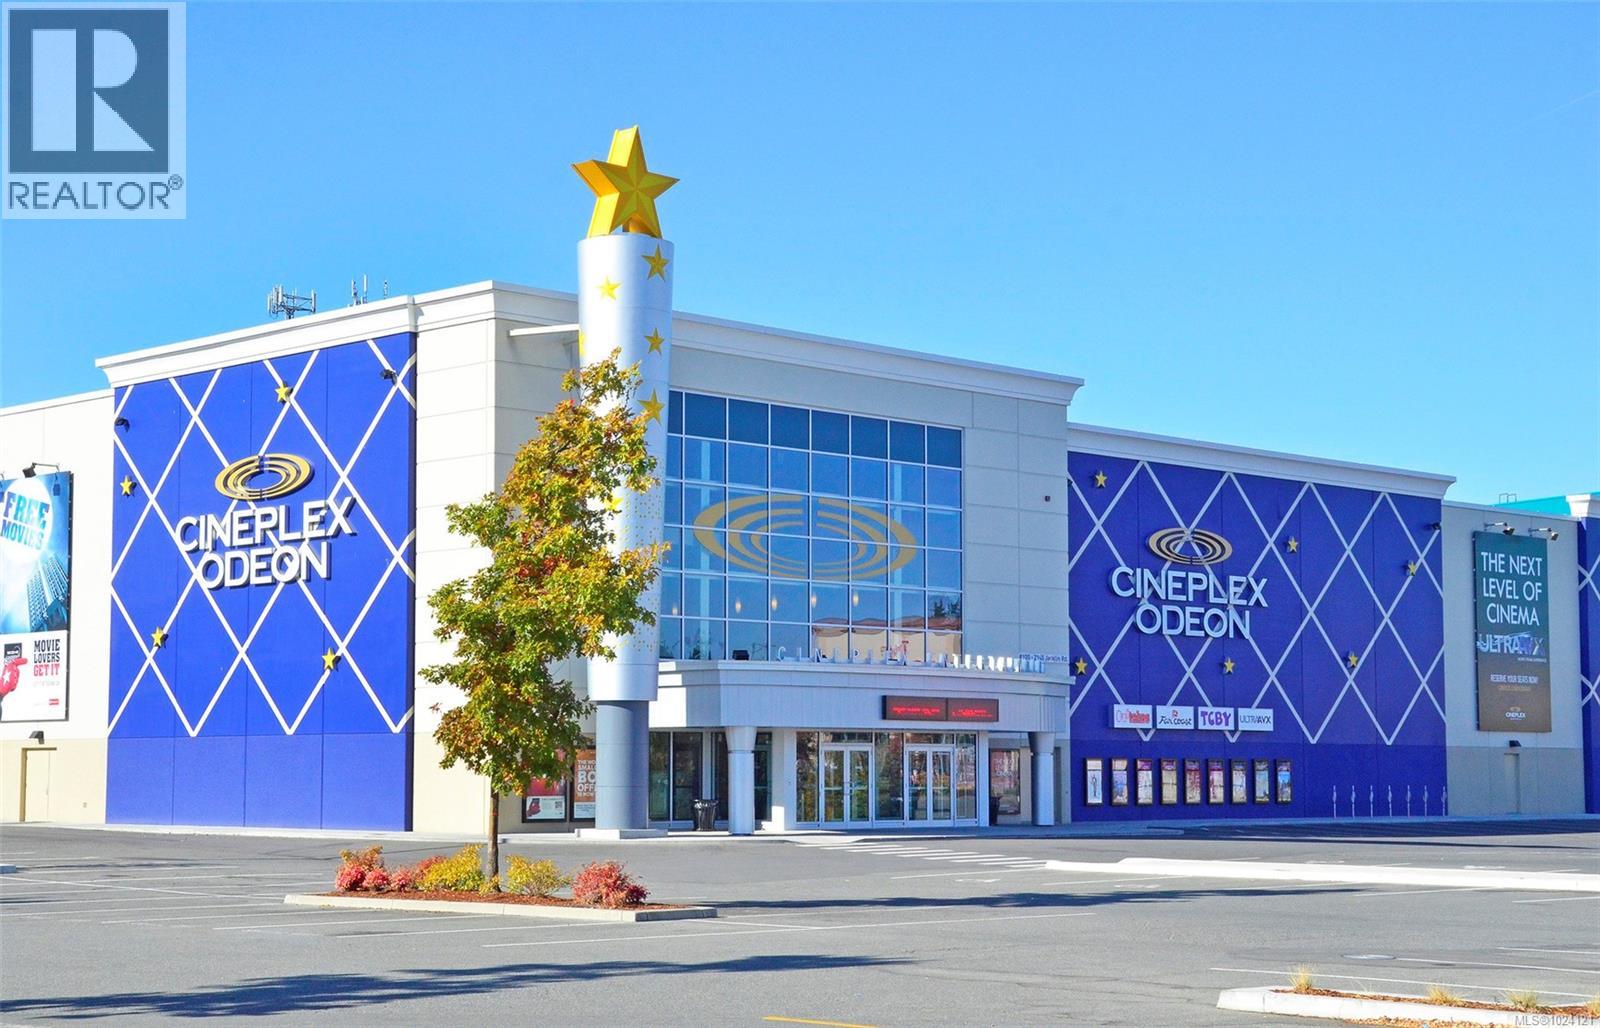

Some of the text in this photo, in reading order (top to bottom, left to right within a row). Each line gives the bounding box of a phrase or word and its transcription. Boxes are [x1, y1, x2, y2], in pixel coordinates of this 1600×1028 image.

[3, 491, 50, 530] FREE
[0, 519, 45, 550] MOVIES
[174, 496, 355, 552] CINEPLEX
[201, 541, 330, 590] ODEON
[1481, 551, 1542, 577] THE NEXT
[1111, 566, 1269, 608] CINEPLEX
[1483, 577, 1542, 602] LEVEL OF
[1135, 604, 1251, 640] ODEON
[1486, 602, 1540, 626] CINEMA
[33, 652, 61, 664] LOVERS
[34, 639, 61, 653] MOVIE
[33, 663, 60, 677] GET IT
[1200, 711, 1231, 726] TCBY
[577, 784, 597, 792] OFF
[578, 770, 597, 784] BO
